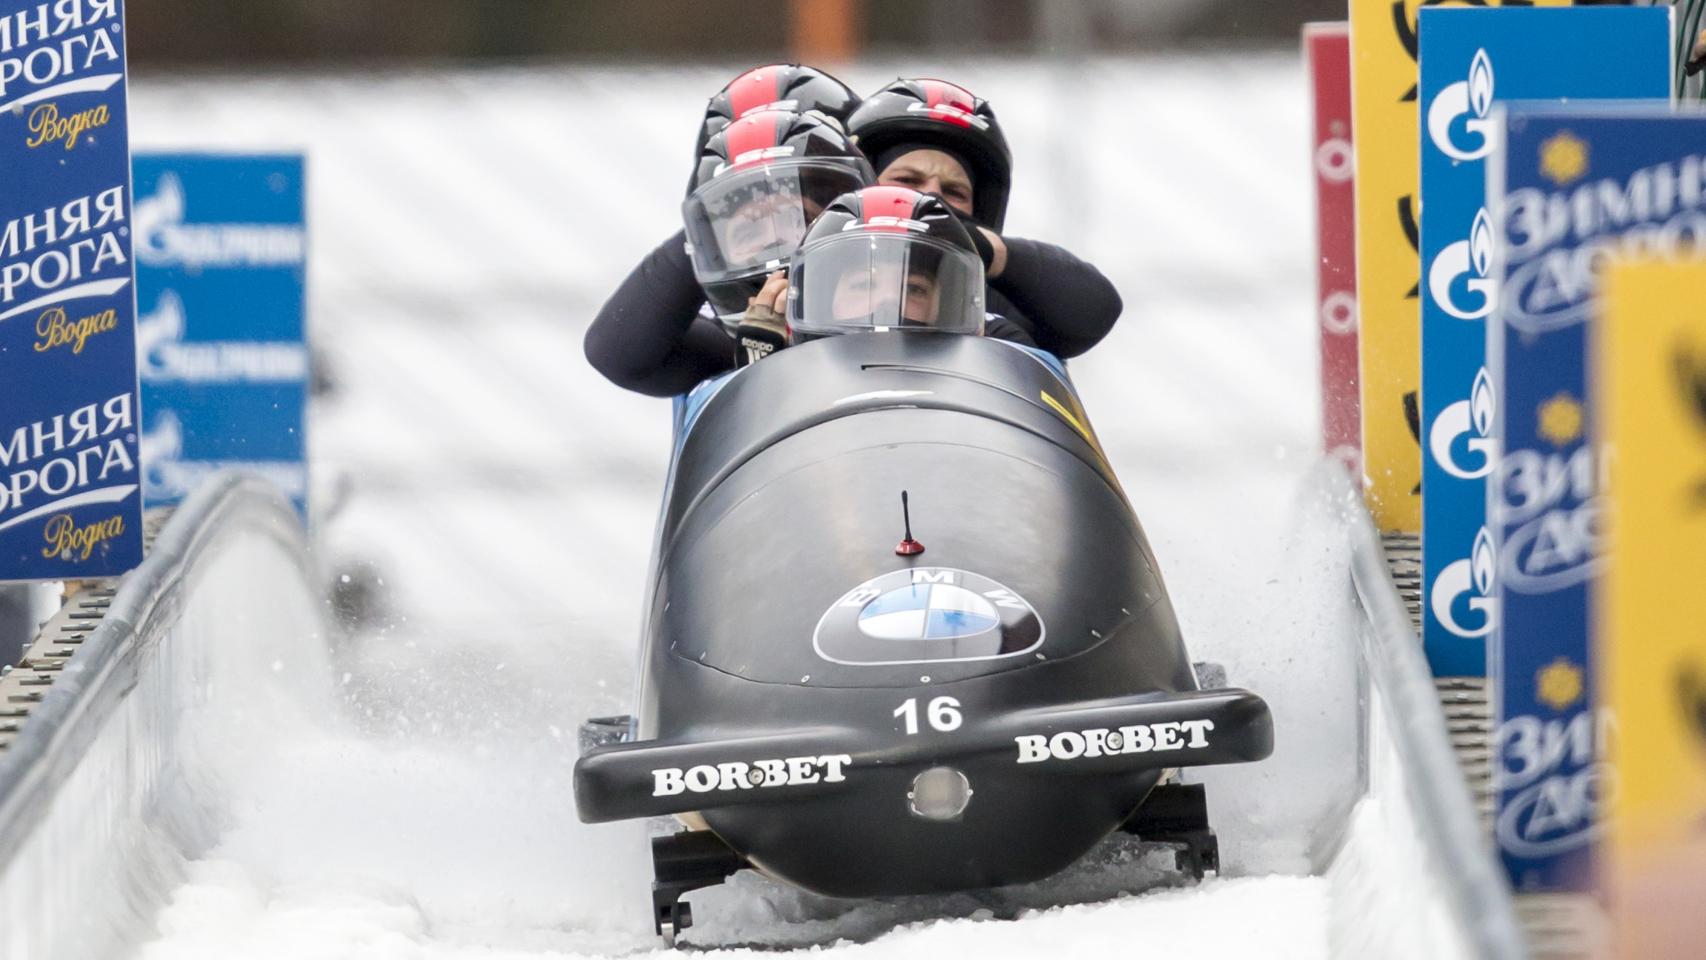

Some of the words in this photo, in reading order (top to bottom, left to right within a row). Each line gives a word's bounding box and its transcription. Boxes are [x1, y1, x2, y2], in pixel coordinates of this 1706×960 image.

[26, 104, 109, 150] Водка
[1500, 153, 1706, 265] ЗИМН
[34, 307, 117, 353] Водка
[0, 438, 134, 512] РОГА
[42, 514, 124, 560] Водка
[840, 570, 1026, 610] BMW
[893, 696, 963, 735] 16
[1015, 718, 1214, 764] BORBET
[652, 754, 852, 797] BORBET
